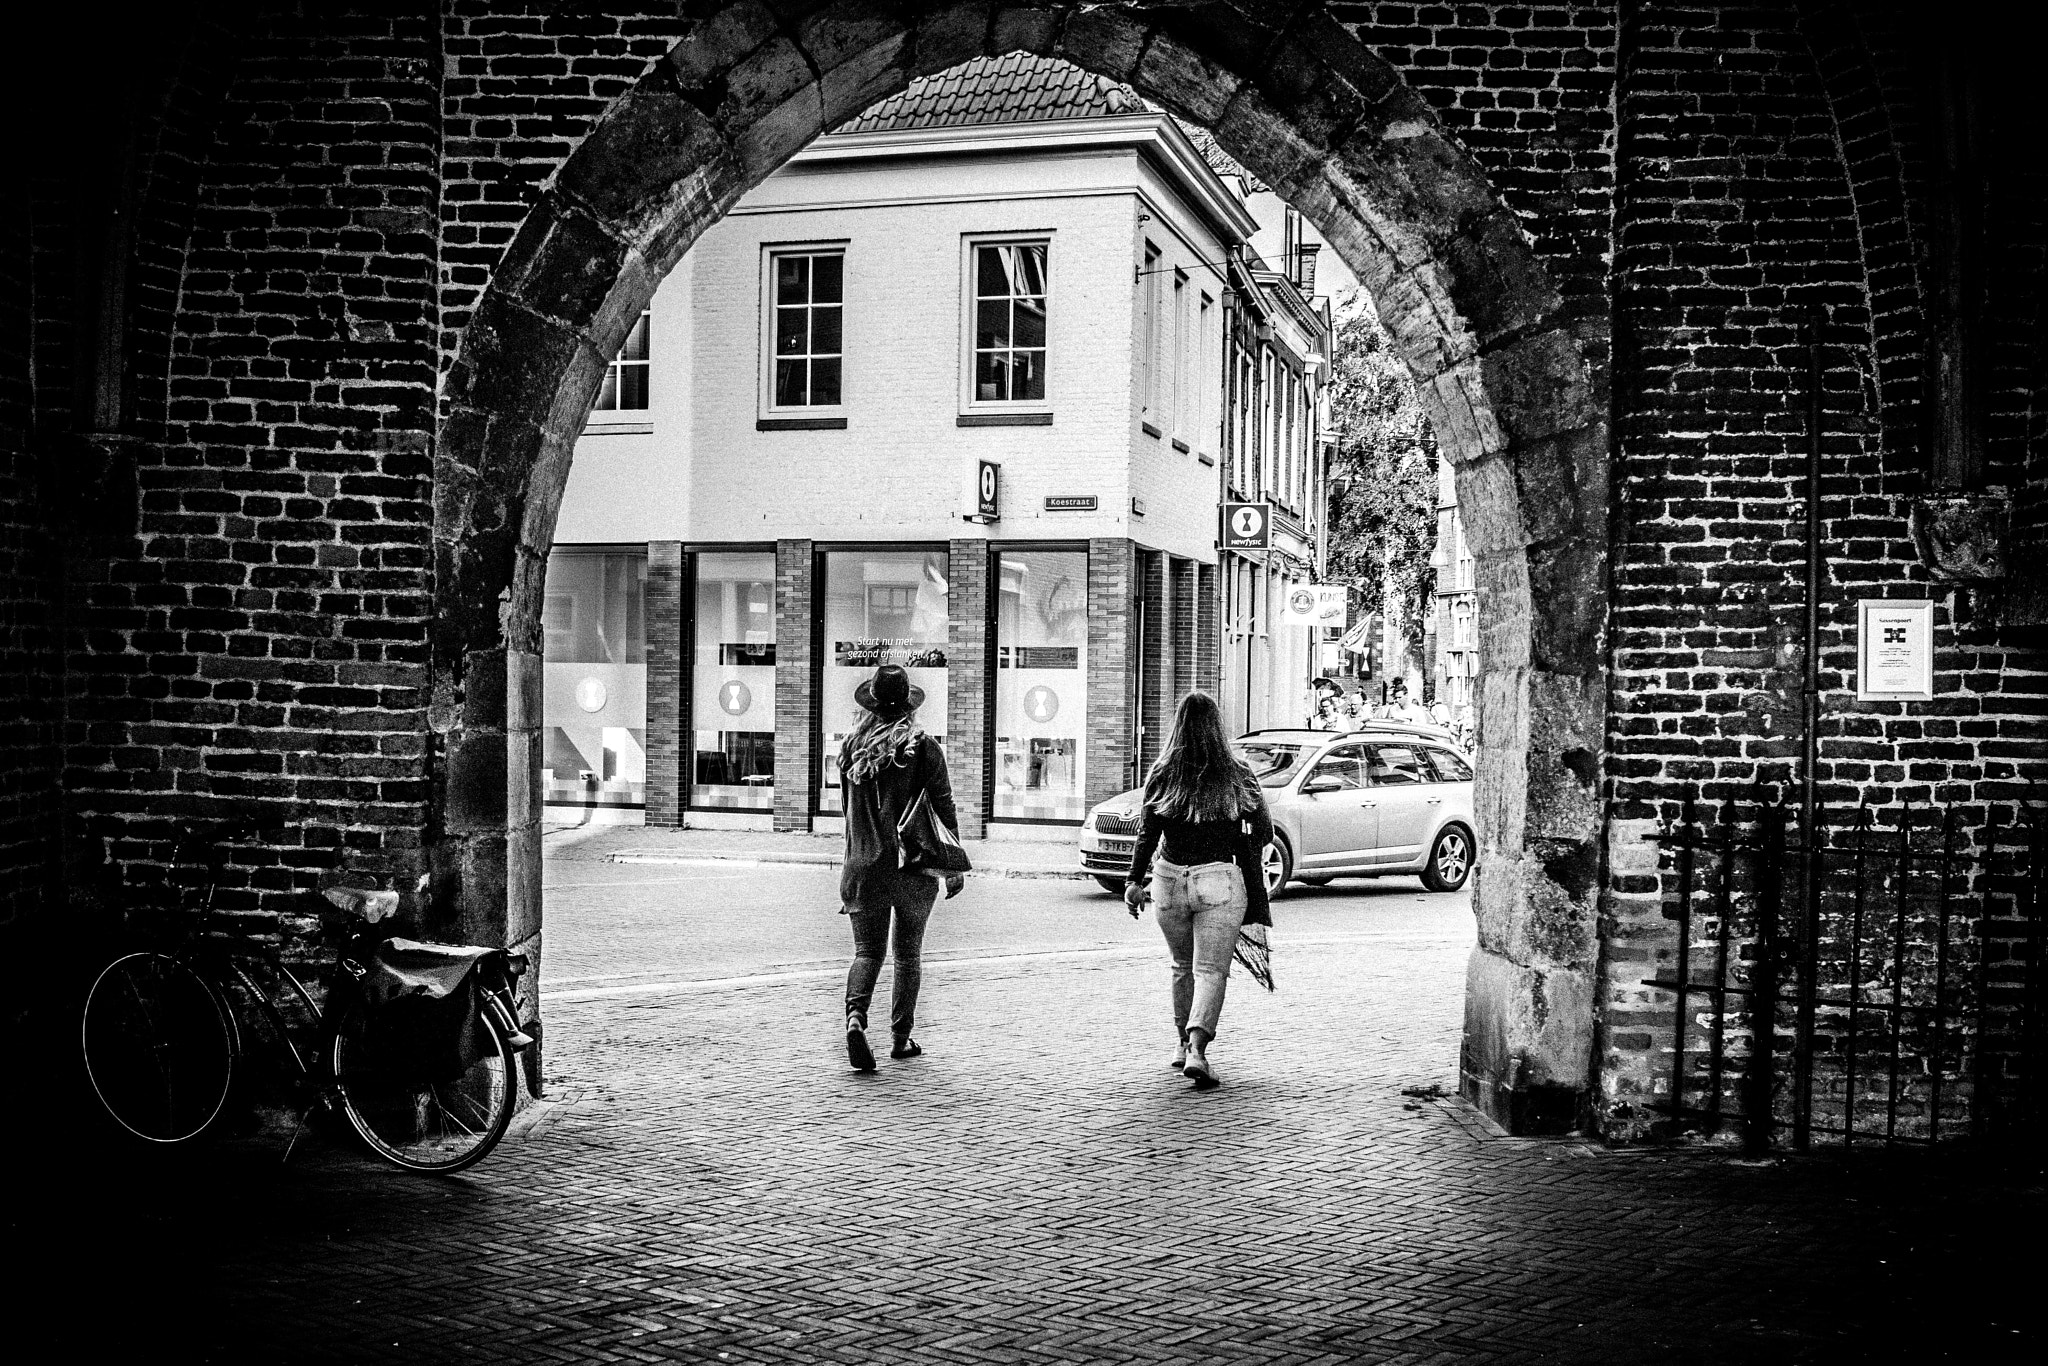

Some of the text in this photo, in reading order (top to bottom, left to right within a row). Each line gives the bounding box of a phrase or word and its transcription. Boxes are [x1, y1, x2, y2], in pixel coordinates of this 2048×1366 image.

[1050, 498, 1090, 506] Koestraat
[858, 637, 914, 646] Start nu met
[847, 649, 879, 660] gezond
[1104, 841, 1134, 852] 3-TKB-7
